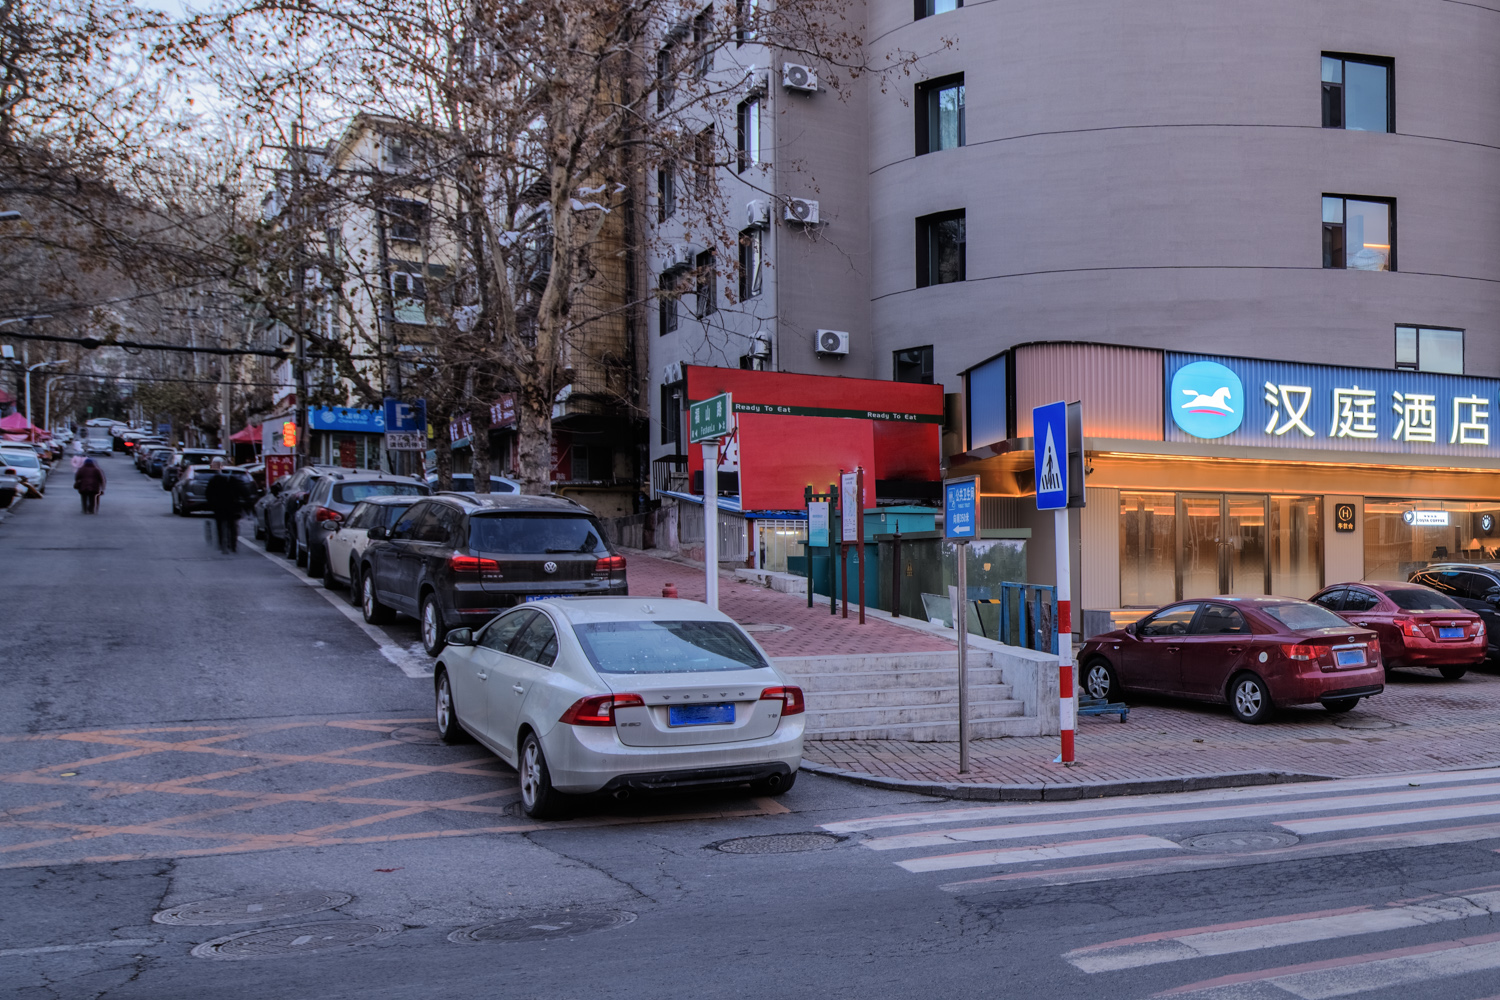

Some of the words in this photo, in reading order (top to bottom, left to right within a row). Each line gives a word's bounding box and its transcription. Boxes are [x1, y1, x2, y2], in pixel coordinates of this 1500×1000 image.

[395, 403, 415, 427] P
[695, 400, 722, 424] 福山路
[735, 403, 761, 413] Ready
[777, 405, 791, 413] Eat
[867, 411, 891, 420] Ready
[893, 412, 901, 420] To
[904, 413, 917, 421] Eat
[1264, 380, 1489, 445] 汉庭酒店
[955, 486, 975, 502] 公共卫生间
[662, 691, 746, 700] VOLVO
